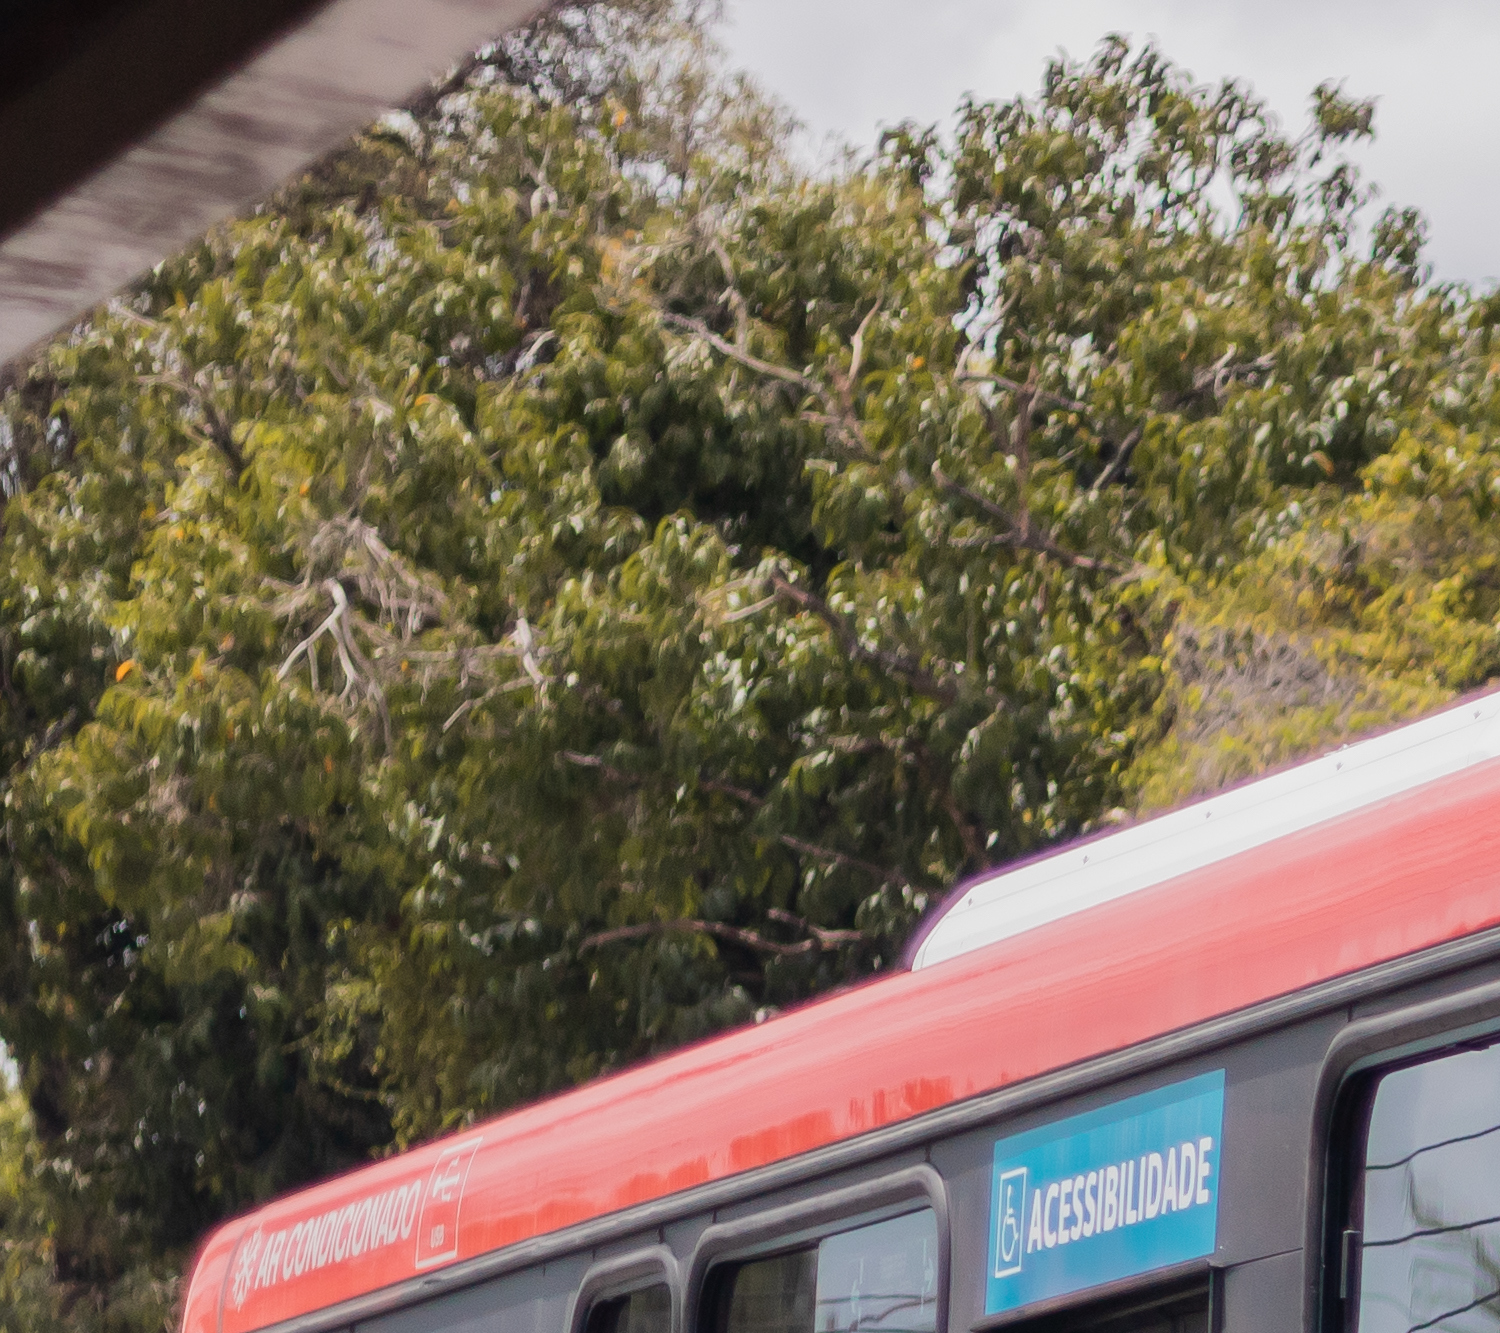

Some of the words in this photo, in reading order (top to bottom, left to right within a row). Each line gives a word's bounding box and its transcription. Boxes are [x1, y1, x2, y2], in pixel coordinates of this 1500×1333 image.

[254, 1230, 286, 1291] AR
[284, 1179, 422, 1282] CONDICIONADO
[1026, 1136, 1212, 1254] ACESSIBILIDADE
